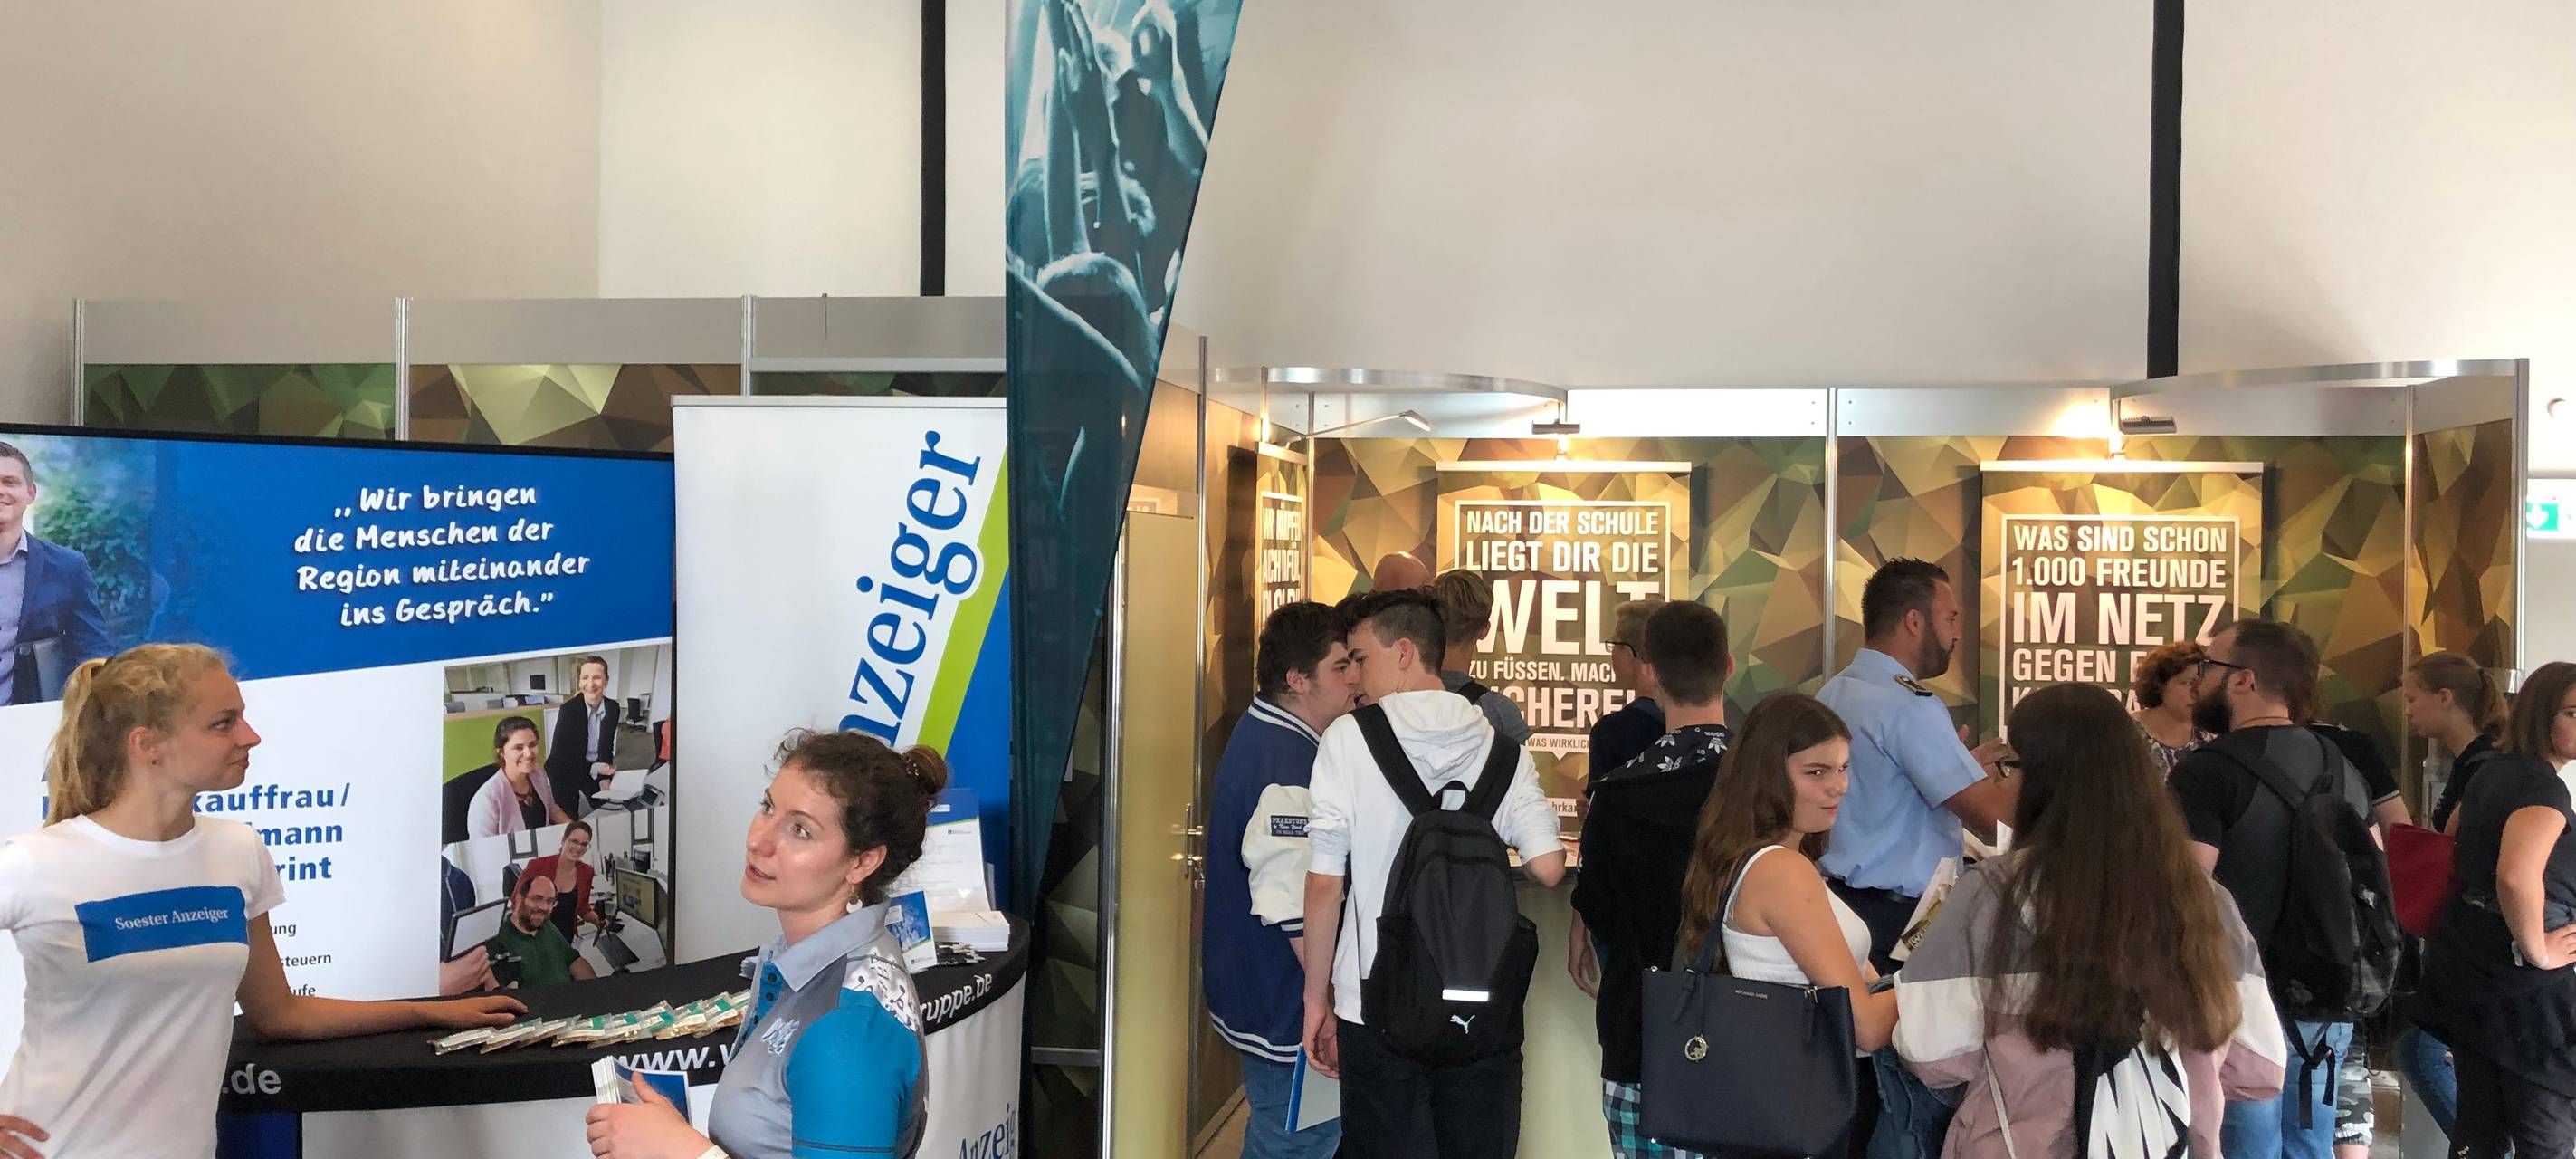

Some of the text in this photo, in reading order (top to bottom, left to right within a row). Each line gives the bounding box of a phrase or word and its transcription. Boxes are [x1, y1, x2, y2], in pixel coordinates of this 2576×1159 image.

[423, 485, 536, 512] bringen
[294, 518, 554, 553] die Menschen der
[1466, 510, 1658, 535] NACH DER SCHULE
[2014, 525, 2227, 552] WAS SIND SCHON
[1466, 541, 1658, 573] LIEGT DIR DIE
[297, 552, 590, 593] Region miteinander
[2012, 557, 2226, 588] 1.000 FREUNDE
[340, 603, 385, 626] ins
[2013, 592, 2226, 647] IM NETZ
[1468, 660, 1487, 679] ZU
[1493, 656, 1565, 681] FÜSSEN.
[2013, 648, 2116, 682] GEGEN
[1527, 738, 1547, 747] WAS
[245, 822, 343, 846] mann
[115, 908, 229, 930] Soester Anzeiger
[284, 954, 331, 967] teuern
